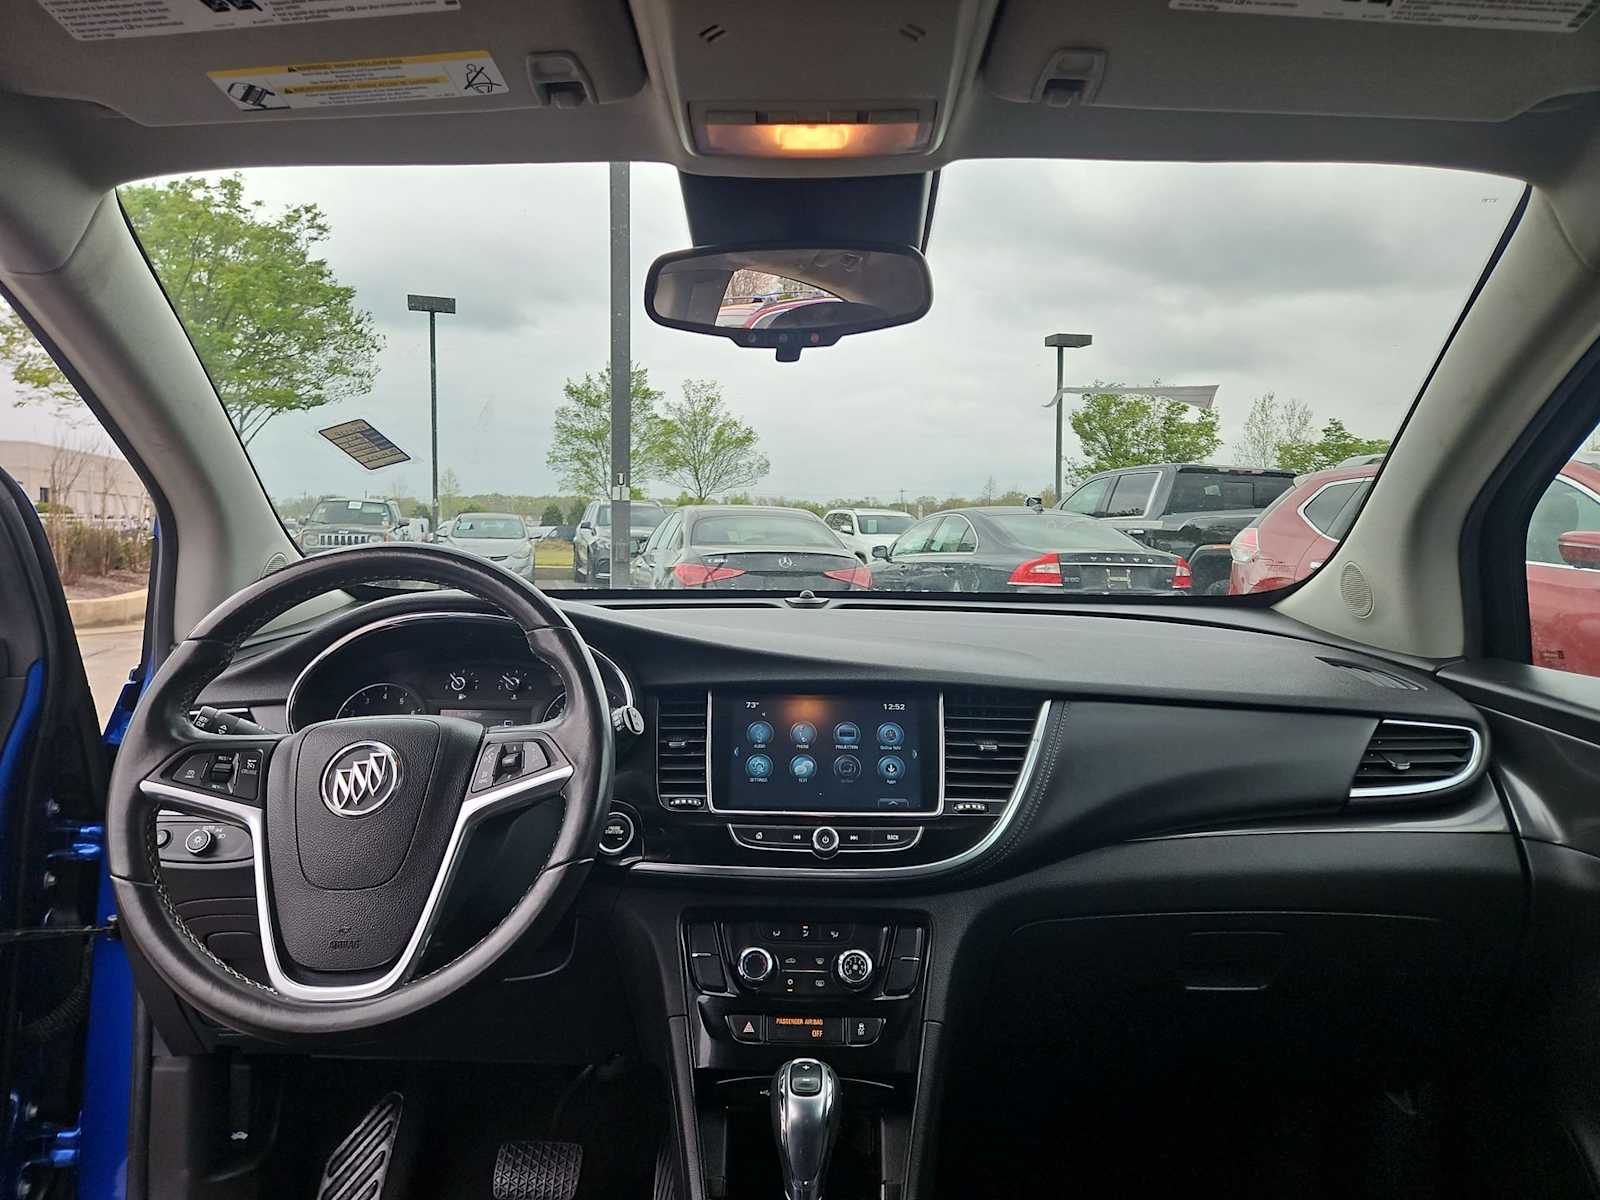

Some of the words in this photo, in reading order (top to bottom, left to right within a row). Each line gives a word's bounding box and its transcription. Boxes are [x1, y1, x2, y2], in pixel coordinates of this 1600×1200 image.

[1090, 556, 1153, 564] VOLVO
[883, 703, 906, 711] 12:52
[775, 1017, 804, 1025] PASSENGER
[804, 1018, 824, 1026] AIRBAG
[811, 1030, 824, 1038] OFF
